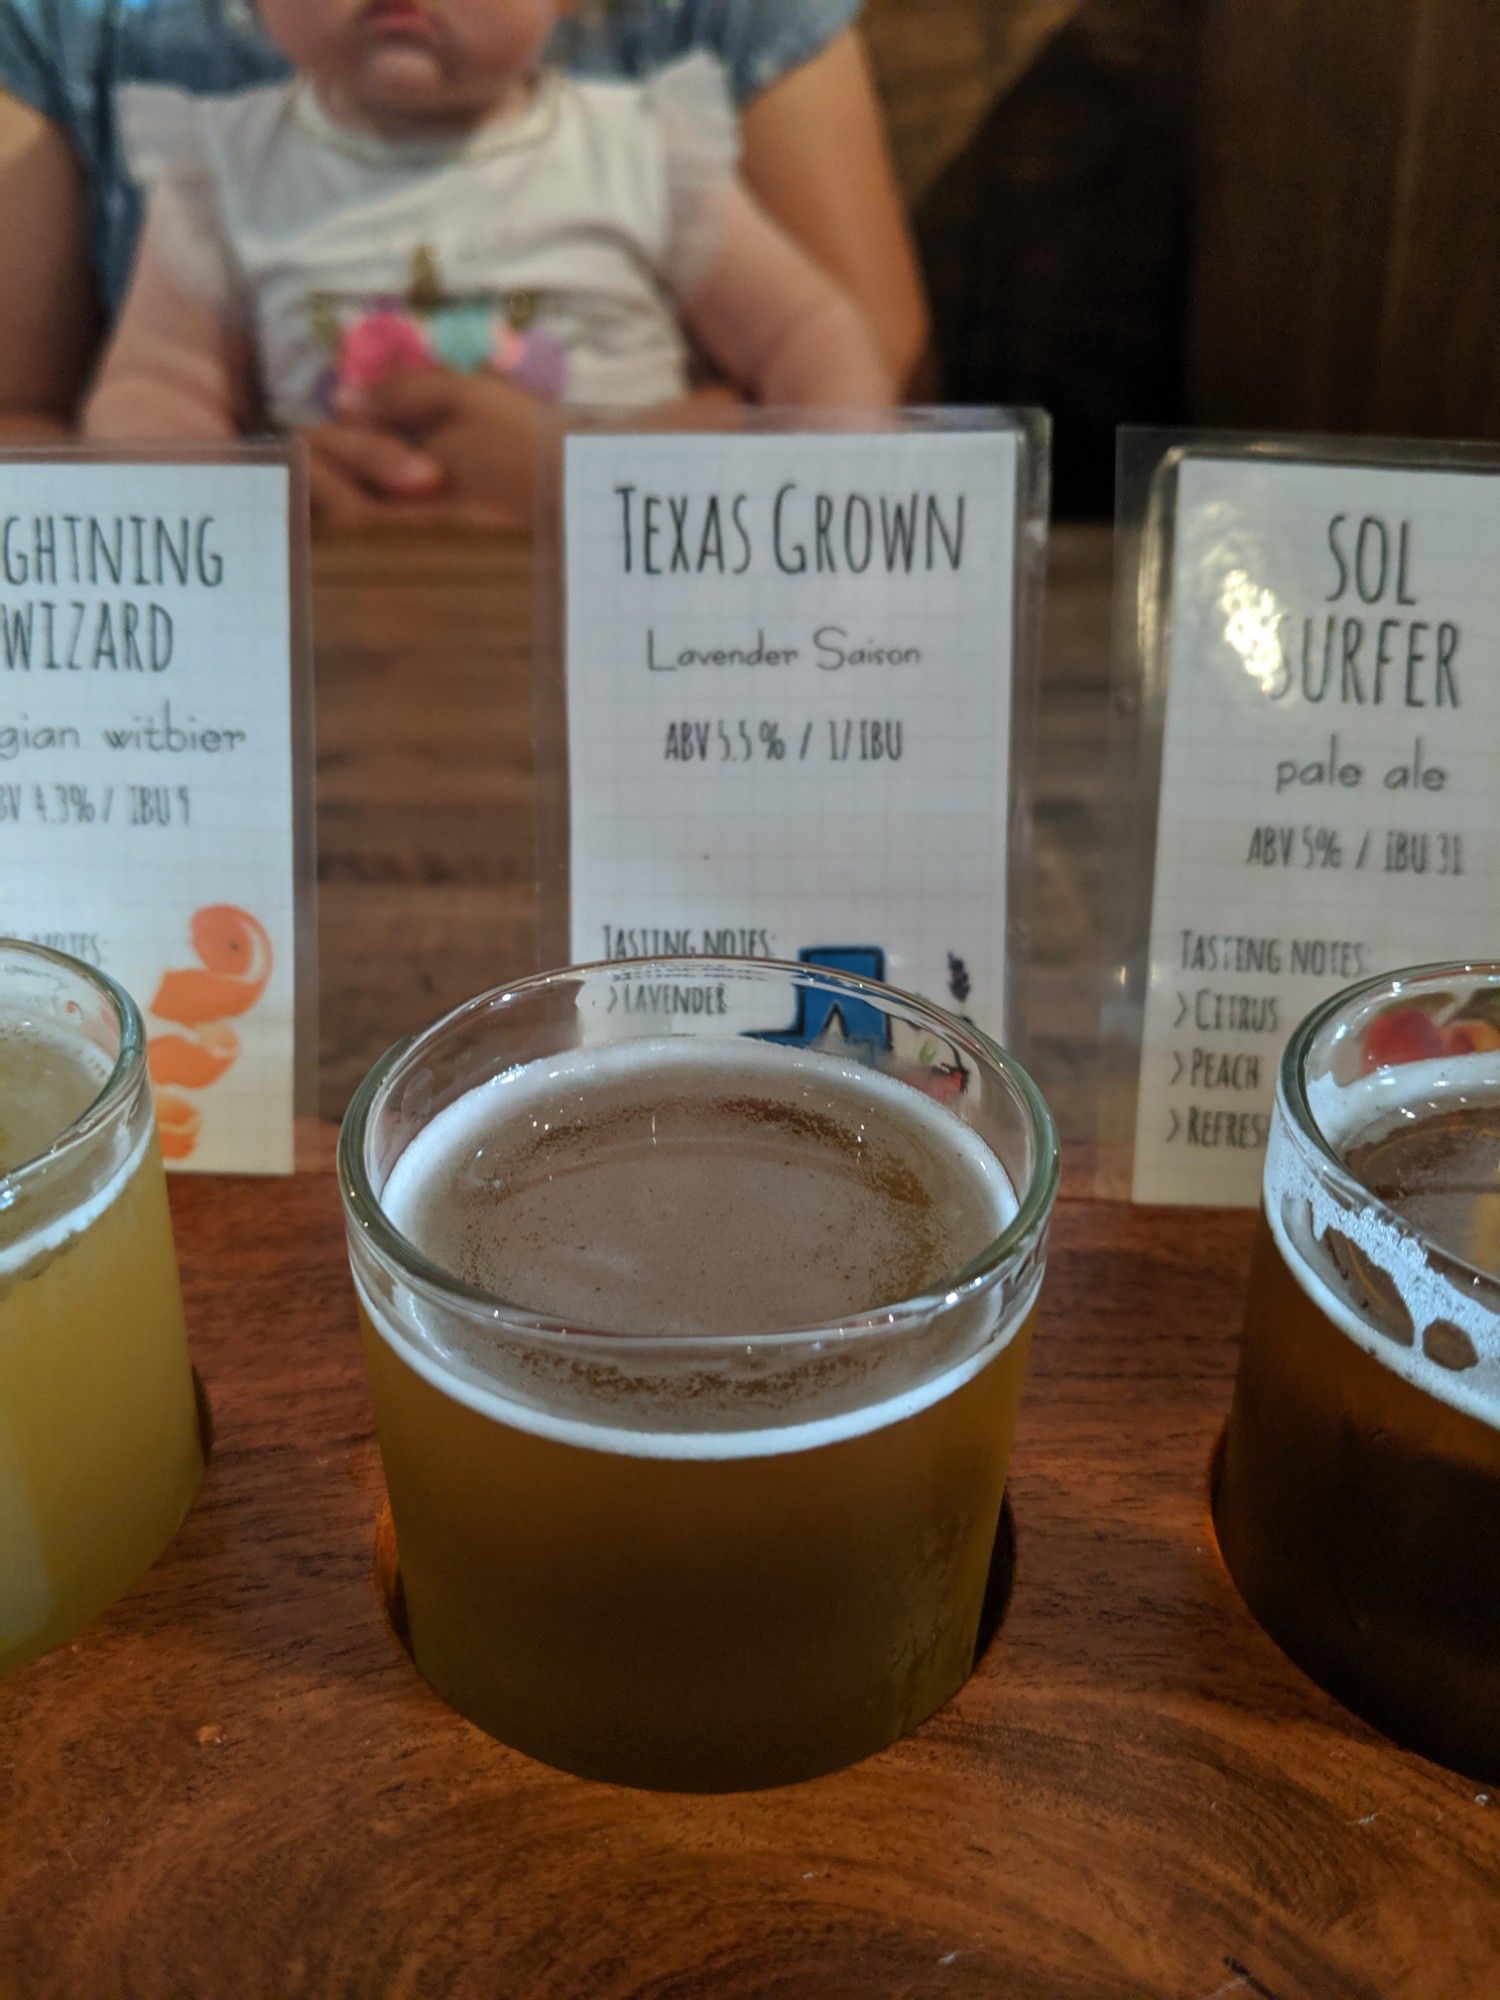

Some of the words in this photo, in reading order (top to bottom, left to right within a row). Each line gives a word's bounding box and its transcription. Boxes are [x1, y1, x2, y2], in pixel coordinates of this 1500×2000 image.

[3, 514, 224, 587] GHTNING
[614, 484, 751, 574] TEXAS
[773, 482, 965, 574] GROWN
[1326, 512, 1418, 606] SOL
[0, 600, 174, 672] WIZARD
[646, 628, 799, 671] Lavender
[812, 625, 922, 671] Saison
[0, 713, 81, 761] gian
[103, 698, 246, 752] witbier
[664, 720, 710, 762] ABV
[859, 719, 903, 761] IBU
[1276, 733, 1362, 794] pale
[1383, 736, 1447, 792] ale
[128, 784, 171, 826] IBU
[1246, 825, 1295, 868] ABV
[1302, 825, 1343, 869] 5%
[1385, 830, 1430, 874] IBU
[603, 925, 697, 959] TASTING
[1180, 928, 1282, 974] TASTING
[1195, 987, 1280, 1033] CITRUS
[1190, 1046, 1259, 1090] PEACH
[1187, 1105, 1270, 1149] REFRES
